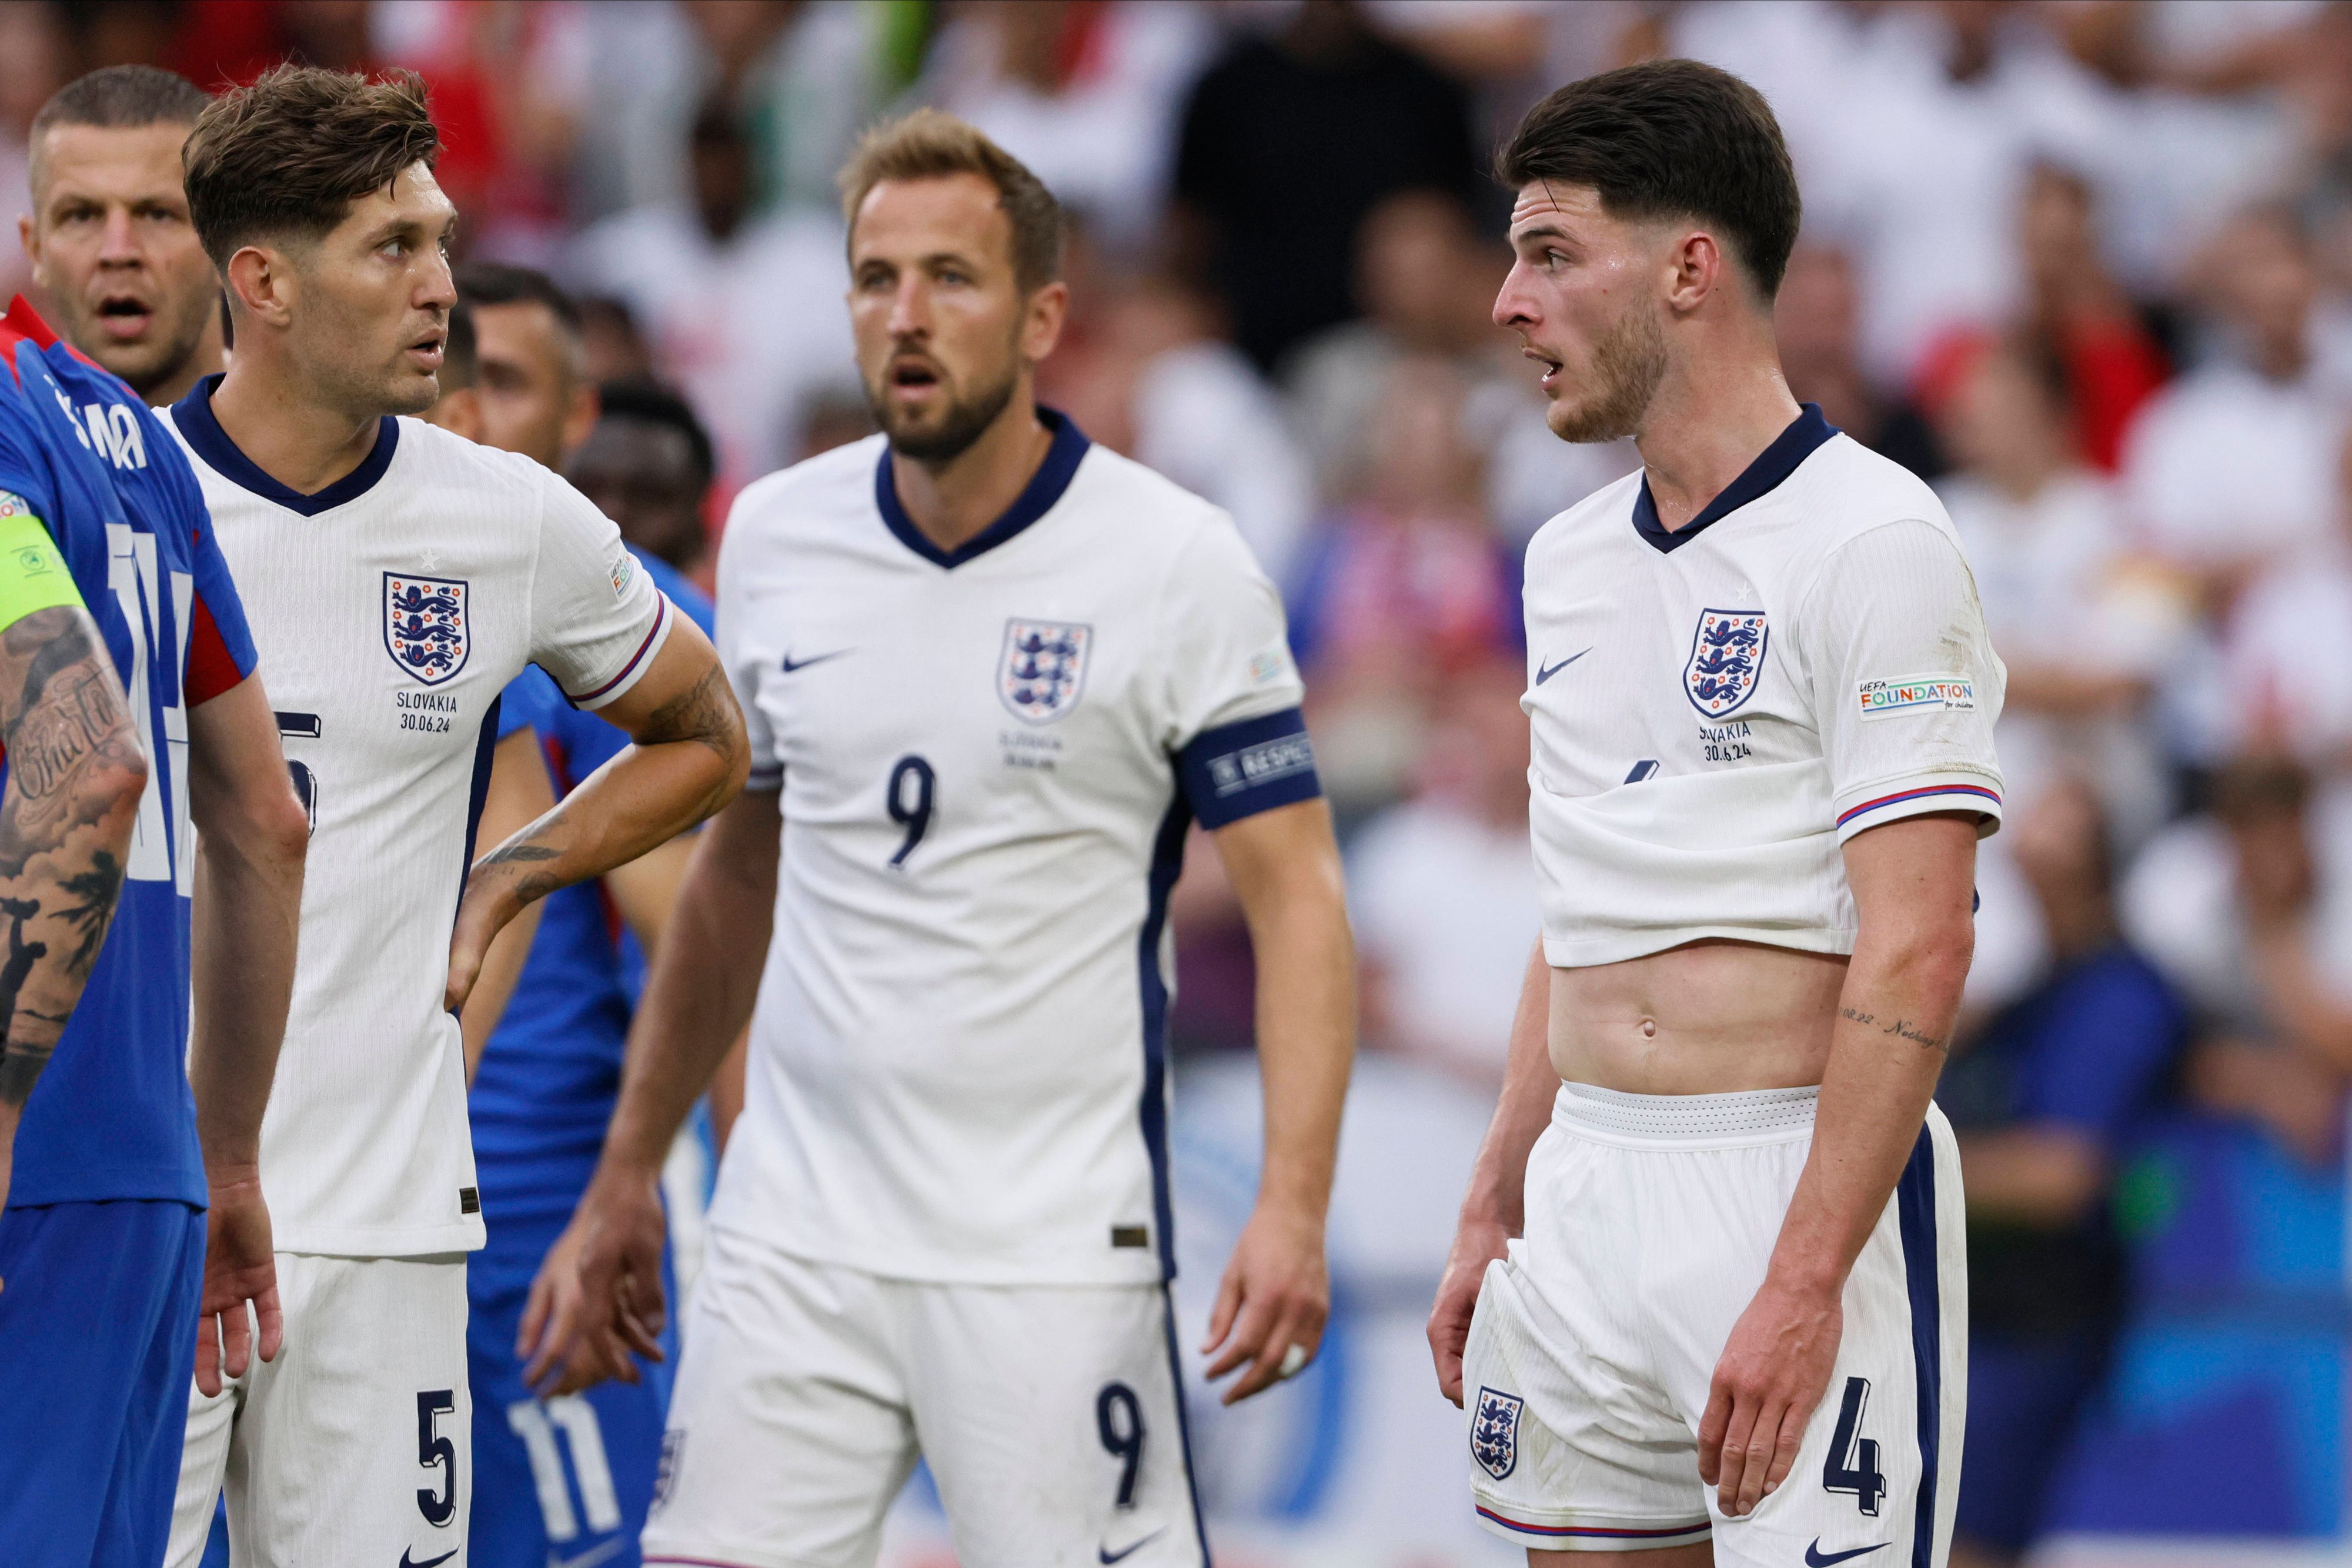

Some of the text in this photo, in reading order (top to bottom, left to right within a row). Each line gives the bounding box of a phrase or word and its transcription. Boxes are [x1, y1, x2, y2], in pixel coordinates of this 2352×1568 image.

[397, 691, 457, 713] SLOVAKIA
[1860, 681, 1887, 693] UEFA
[1861, 684, 1973, 708] FOUNDATION
[1945, 700, 1953, 710] for
[400, 713, 450, 733] 30.06.24
[888, 755, 937, 869] 9
[417, 1389, 457, 1528] 5
[507, 1392, 621, 1542] 11
[1096, 1383, 1147, 1509] 9
[1823, 1376, 1886, 1517] 4
